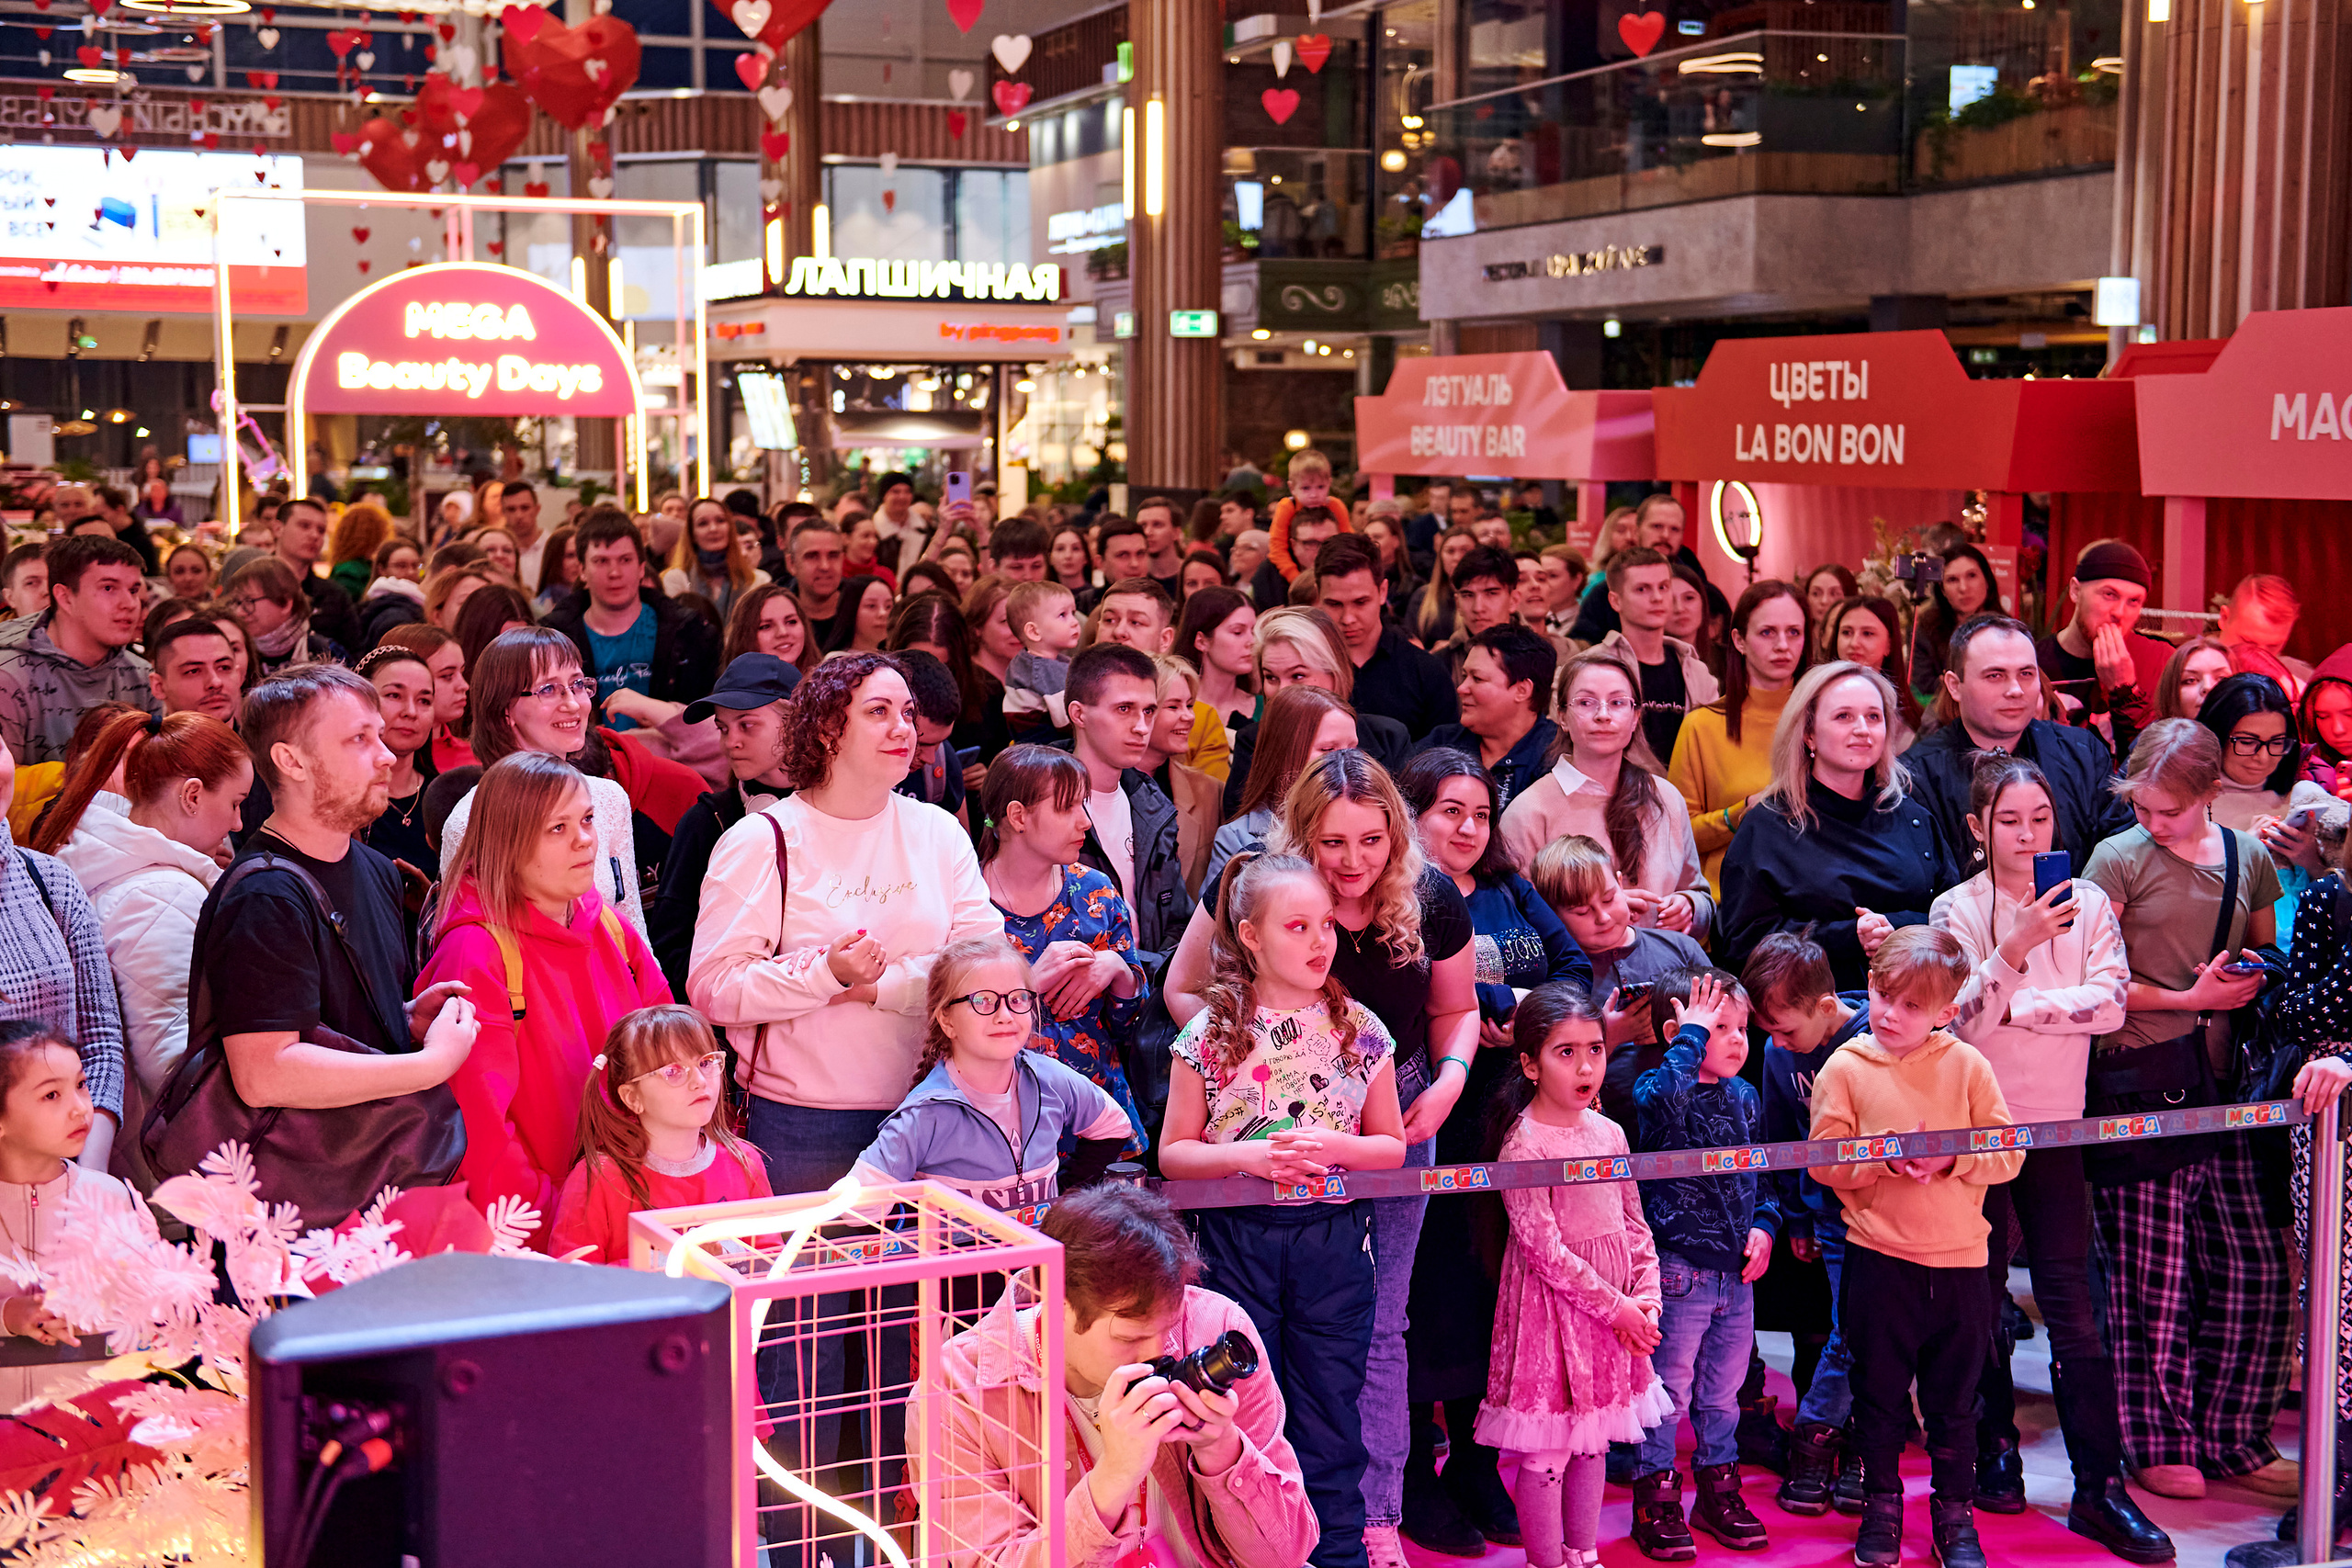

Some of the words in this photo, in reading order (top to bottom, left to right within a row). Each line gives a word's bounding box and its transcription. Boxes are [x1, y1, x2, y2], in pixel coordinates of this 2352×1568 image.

[785, 256, 1060, 301] ЛАПШИЧНАЯ
[404, 301, 537, 341] MEGA
[338, 352, 493, 399] Beauty
[497, 355, 604, 400] Days
[1422, 374, 1513, 406] ЛЭТУАЛЬ
[1770, 359, 1869, 409] ЦВЕТЫ
[1410, 424, 1483, 457] BEAUTY
[1485, 424, 1526, 457] BAR
[1736, 423, 1769, 462] LA
[1773, 423, 1833, 464] BON
[1839, 423, 1905, 465] BON
[827, 874, 918, 908] Exclusive
